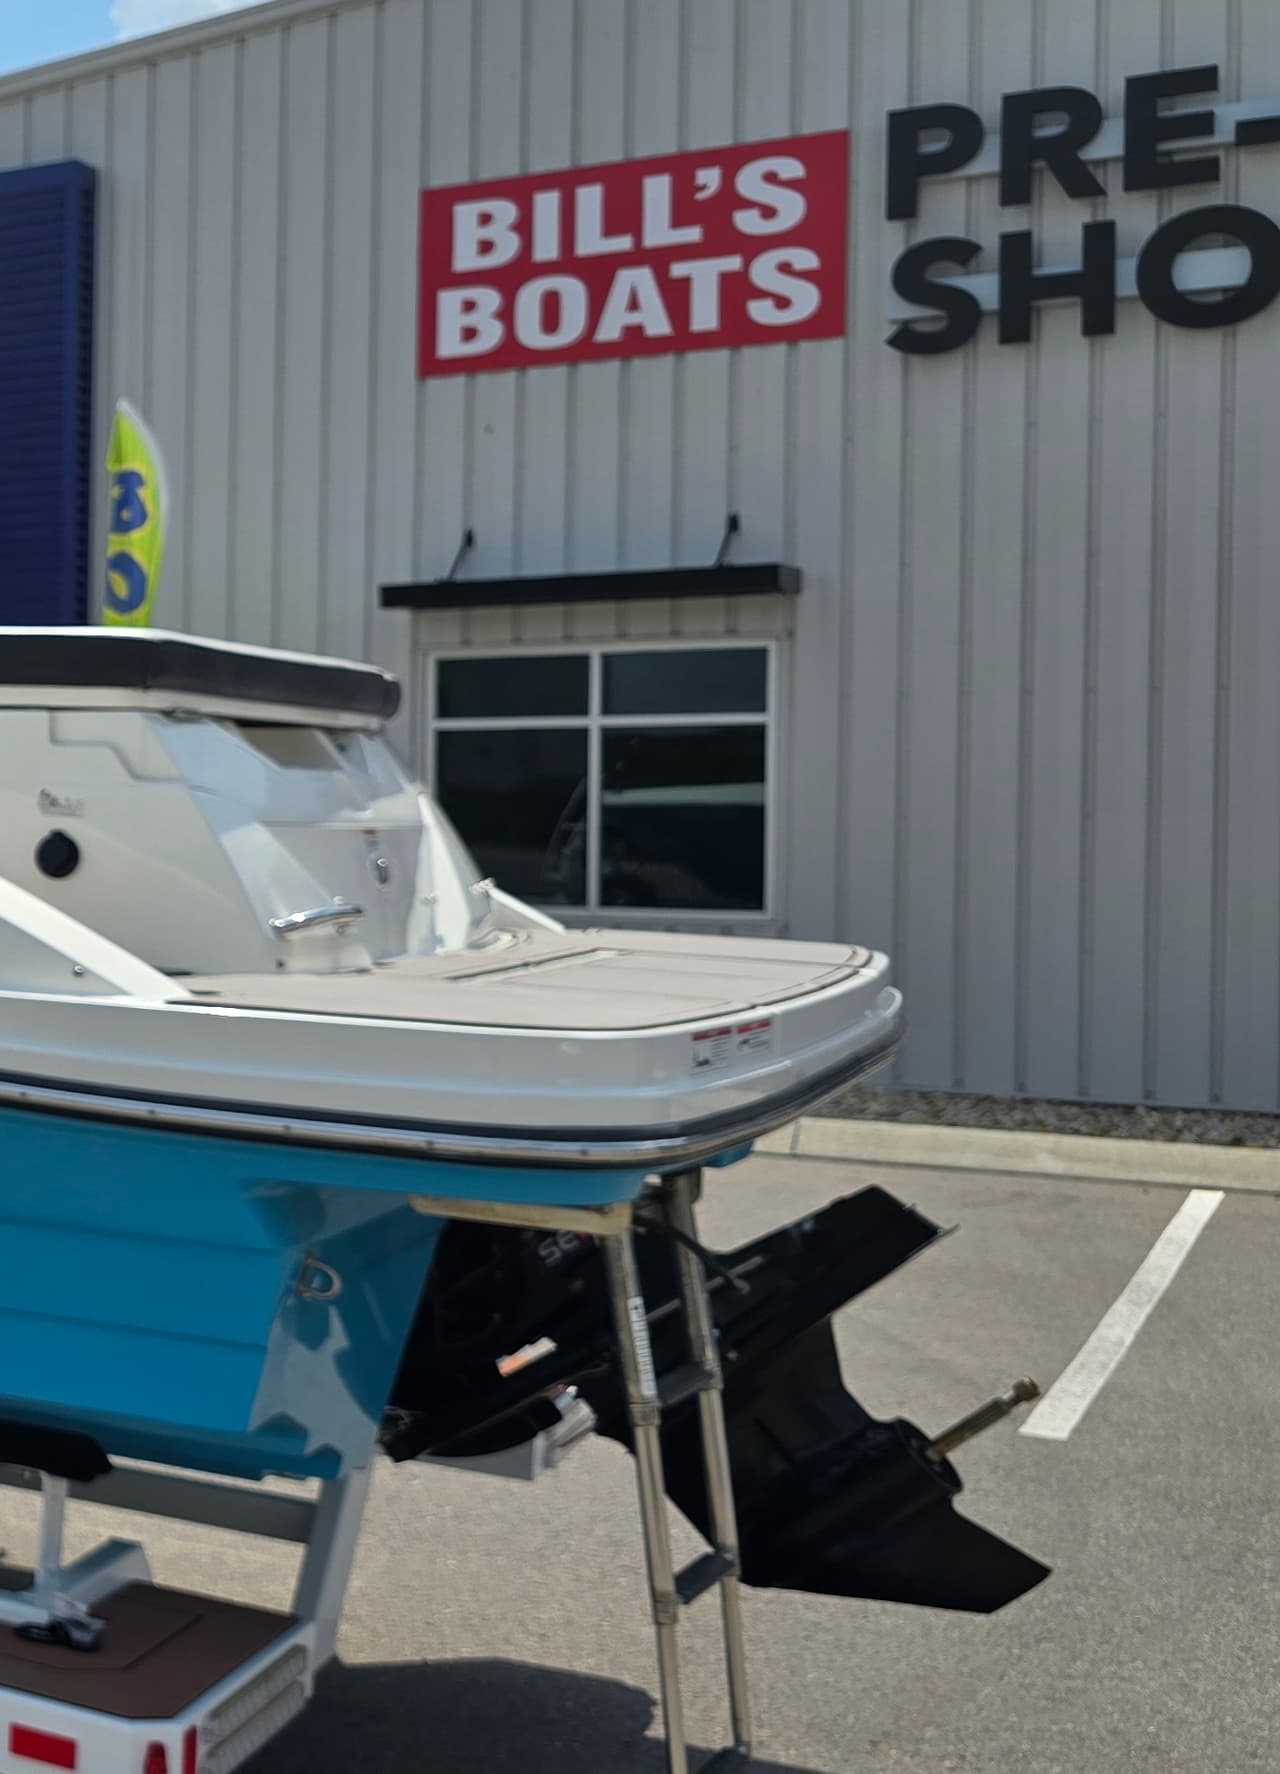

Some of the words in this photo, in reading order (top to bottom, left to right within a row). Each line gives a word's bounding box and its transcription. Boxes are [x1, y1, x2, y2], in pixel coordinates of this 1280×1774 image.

[886, 64, 1280, 221] PRE-
[451, 154, 808, 273] BILL'S
[435, 247, 822, 359] BOATS
[885, 204, 1280, 356] SHO
[537, 1230, 578, 1267] SE
